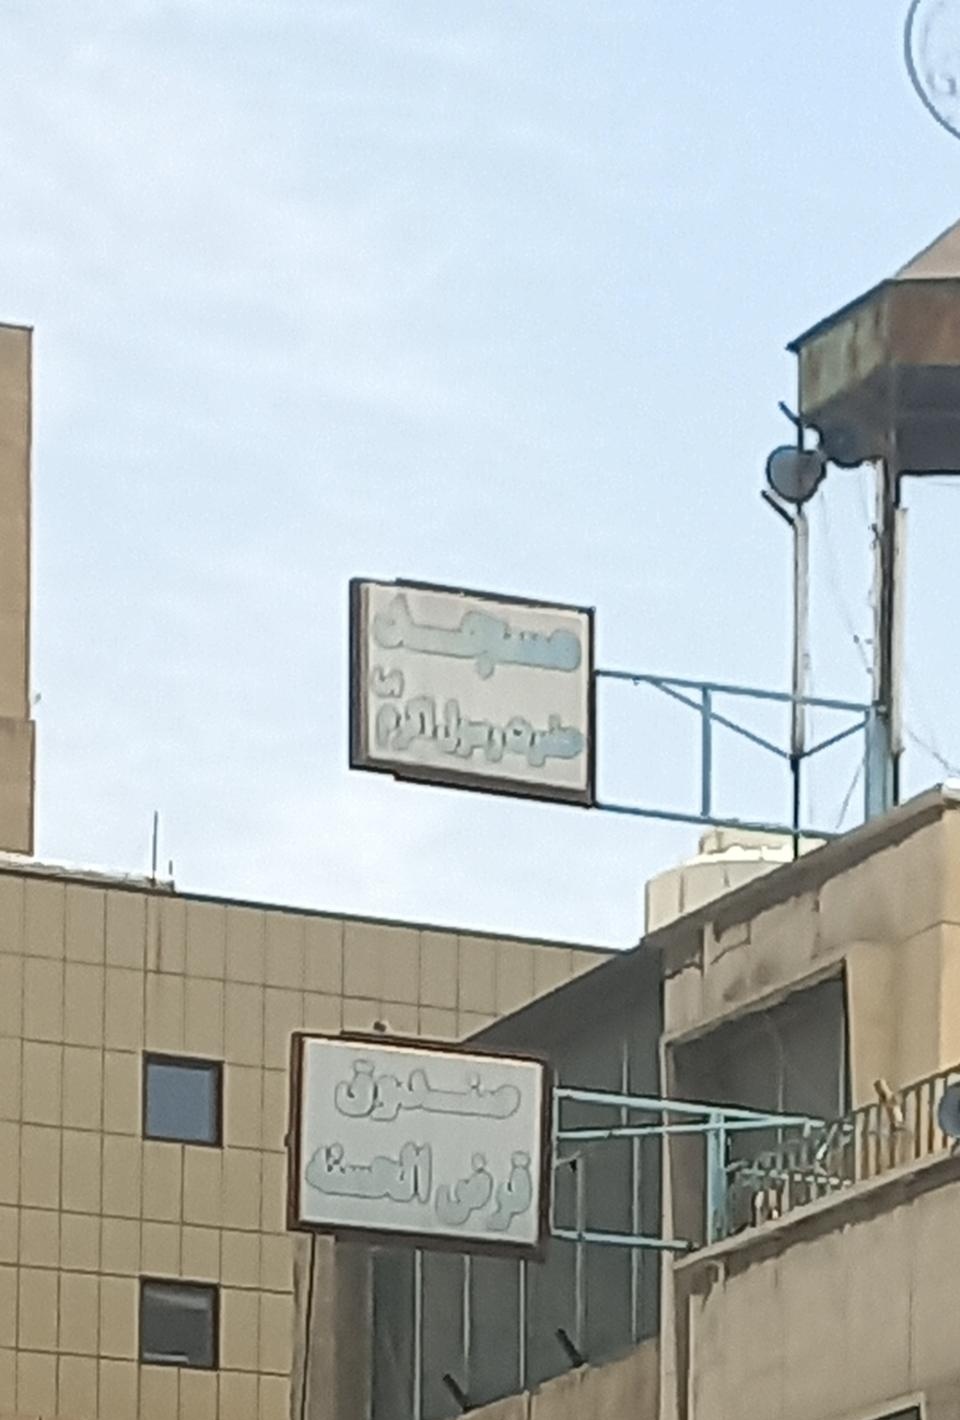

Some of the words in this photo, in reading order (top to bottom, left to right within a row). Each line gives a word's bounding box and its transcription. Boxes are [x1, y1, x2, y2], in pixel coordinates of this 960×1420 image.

[374, 593, 582, 680] مسجد
[334, 1059, 521, 1121] صندوق
[434, 1150, 533, 1231] قرض
